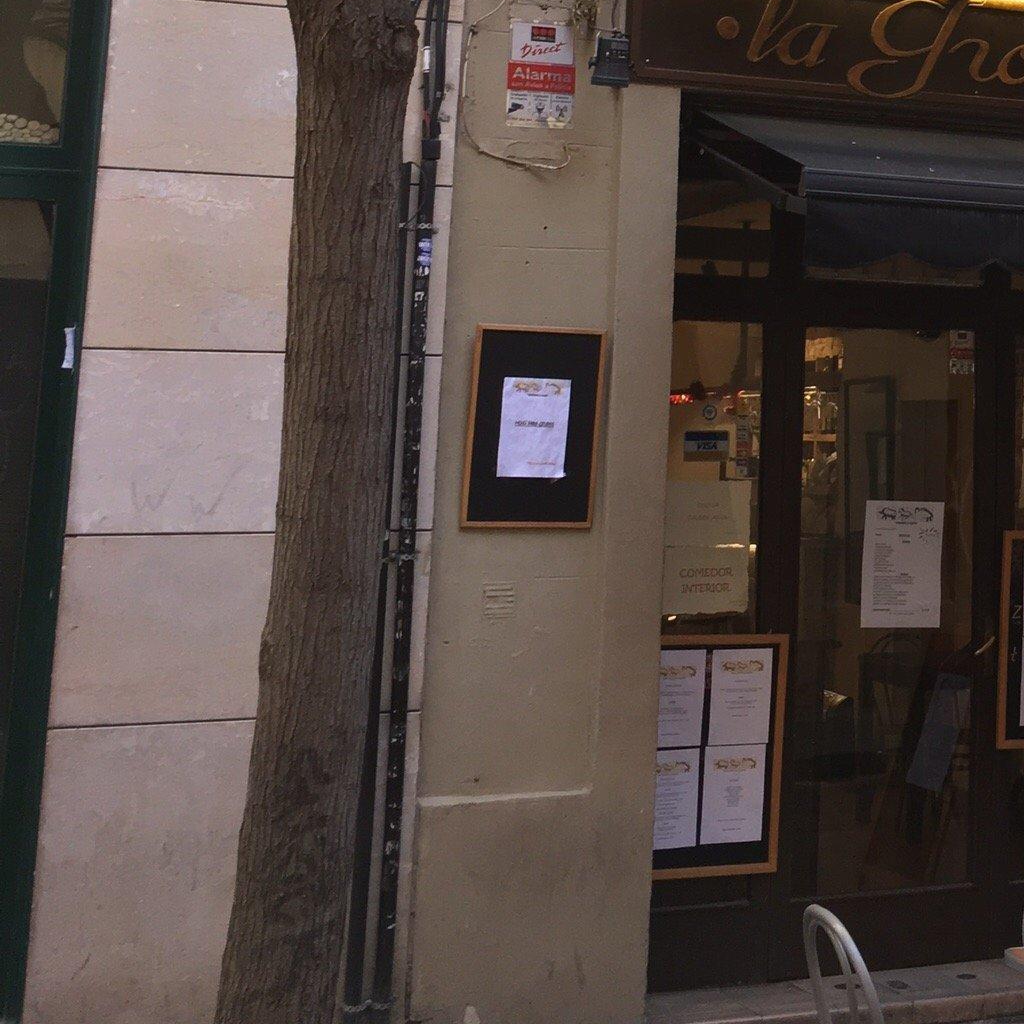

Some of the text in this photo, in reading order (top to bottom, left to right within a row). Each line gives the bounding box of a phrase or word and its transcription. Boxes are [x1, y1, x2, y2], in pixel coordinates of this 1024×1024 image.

[520, 42, 566, 59] Direct
[512, 66, 572, 83] Alarma
[697, 441, 717, 450] VISA
[679, 567, 734, 578] COMEDOR
[680, 582, 732, 594] INTERIOR
